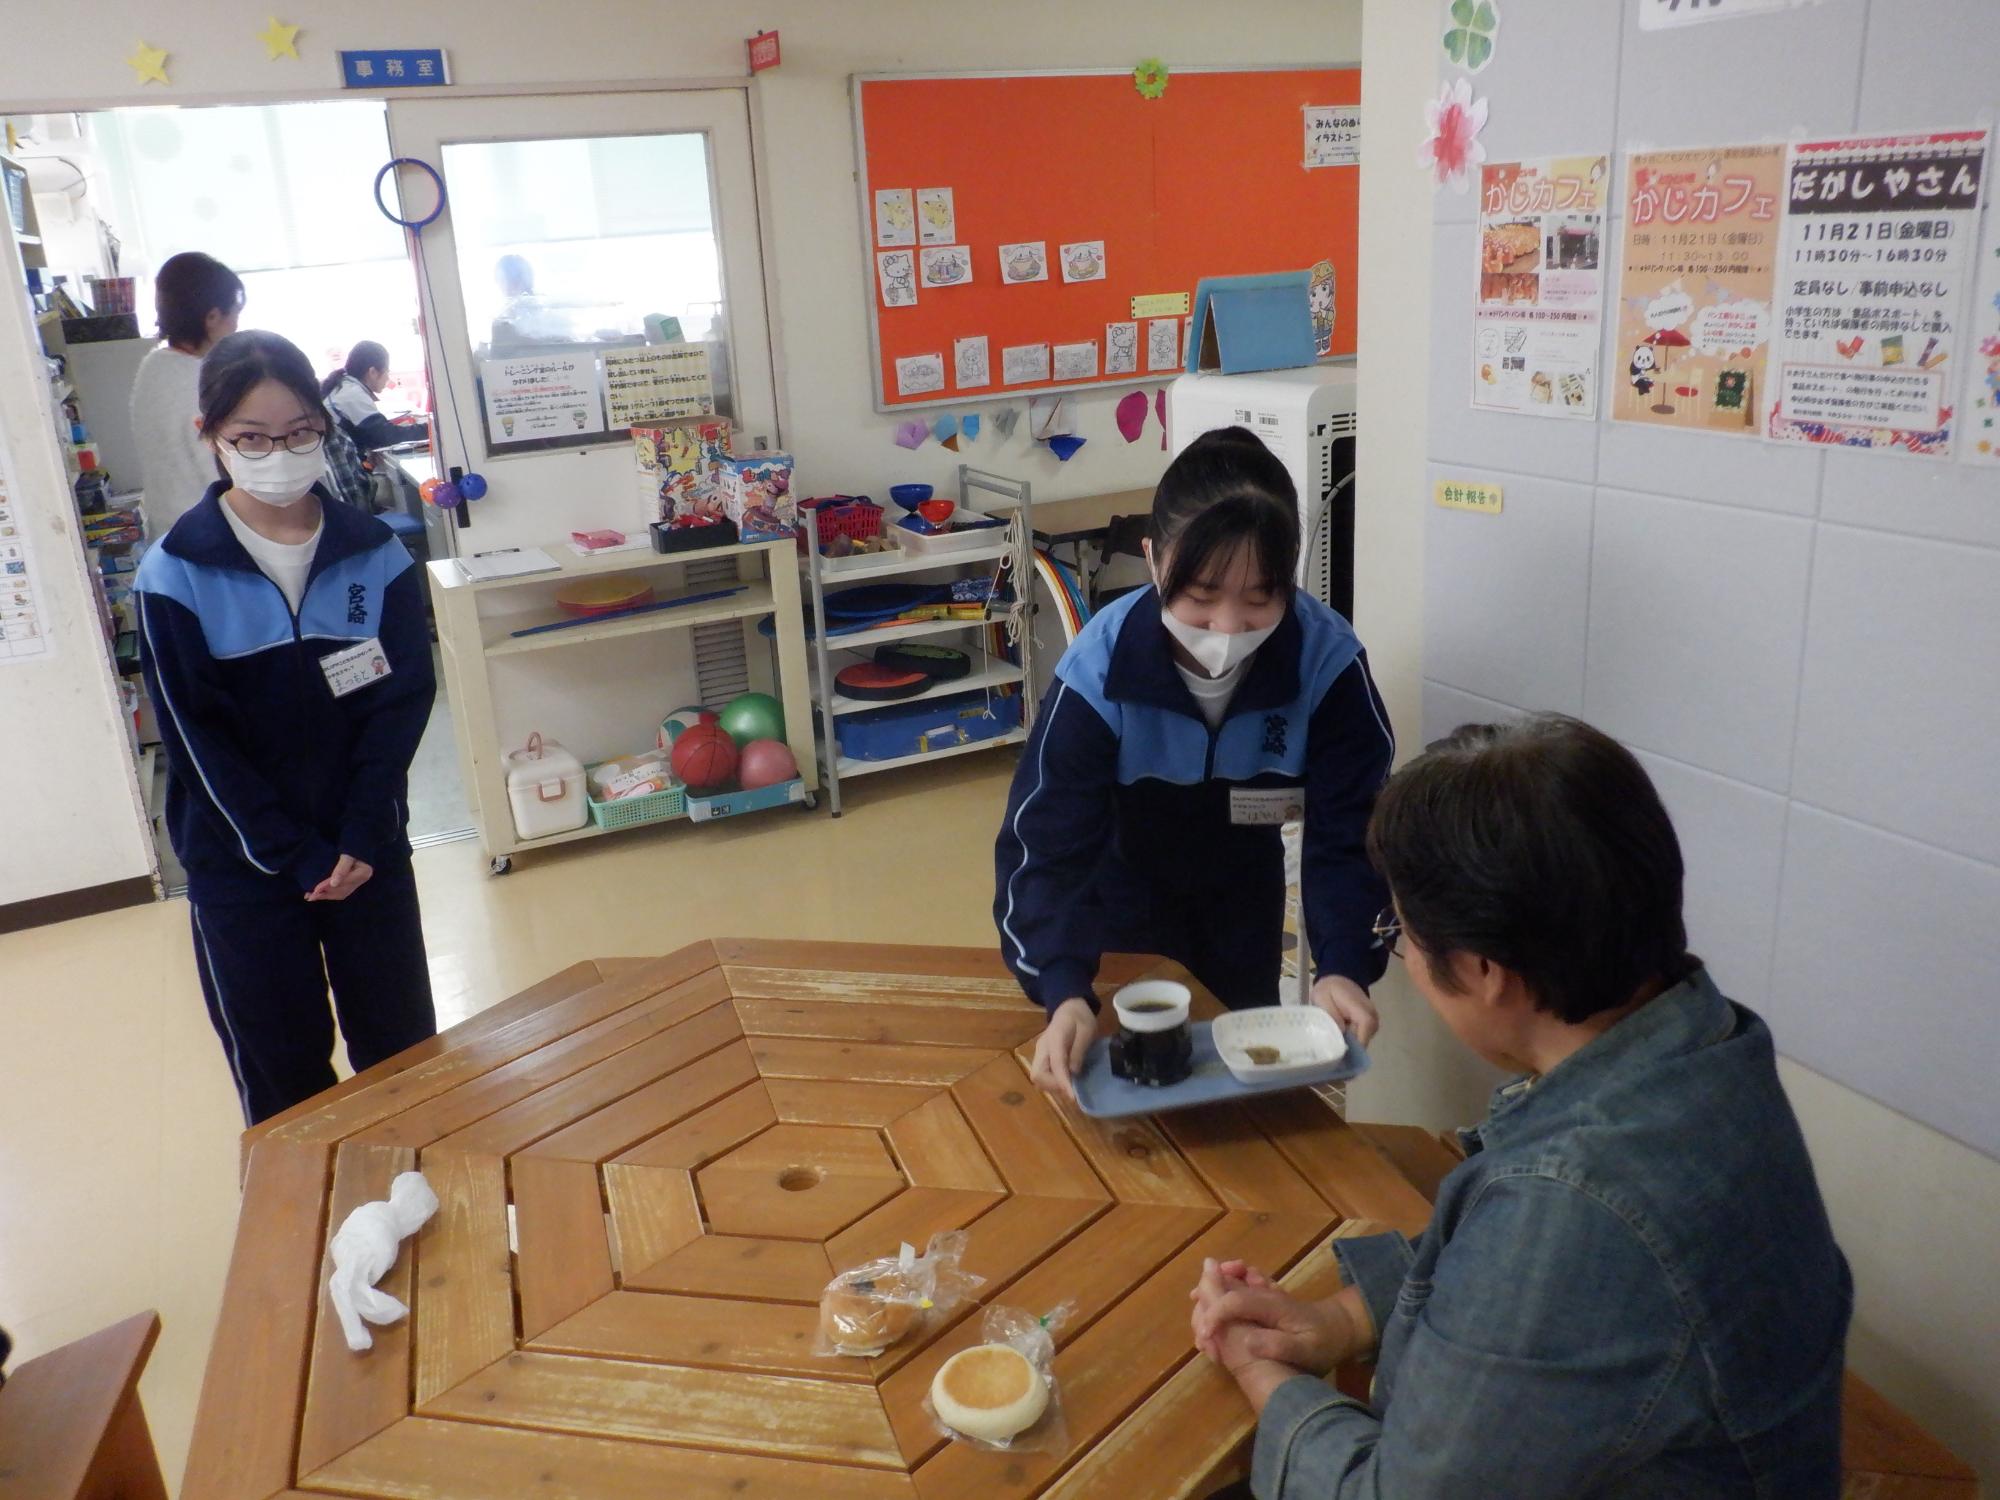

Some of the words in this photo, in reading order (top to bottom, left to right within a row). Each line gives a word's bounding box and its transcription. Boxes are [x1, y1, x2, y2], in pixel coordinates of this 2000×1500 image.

[354, 59, 435, 78] 事務室
[1485, 178, 1596, 214] かじカフェ
[1791, 164, 1977, 201] だがしやさん
[1631, 177, 1775, 225] かじカフェ
